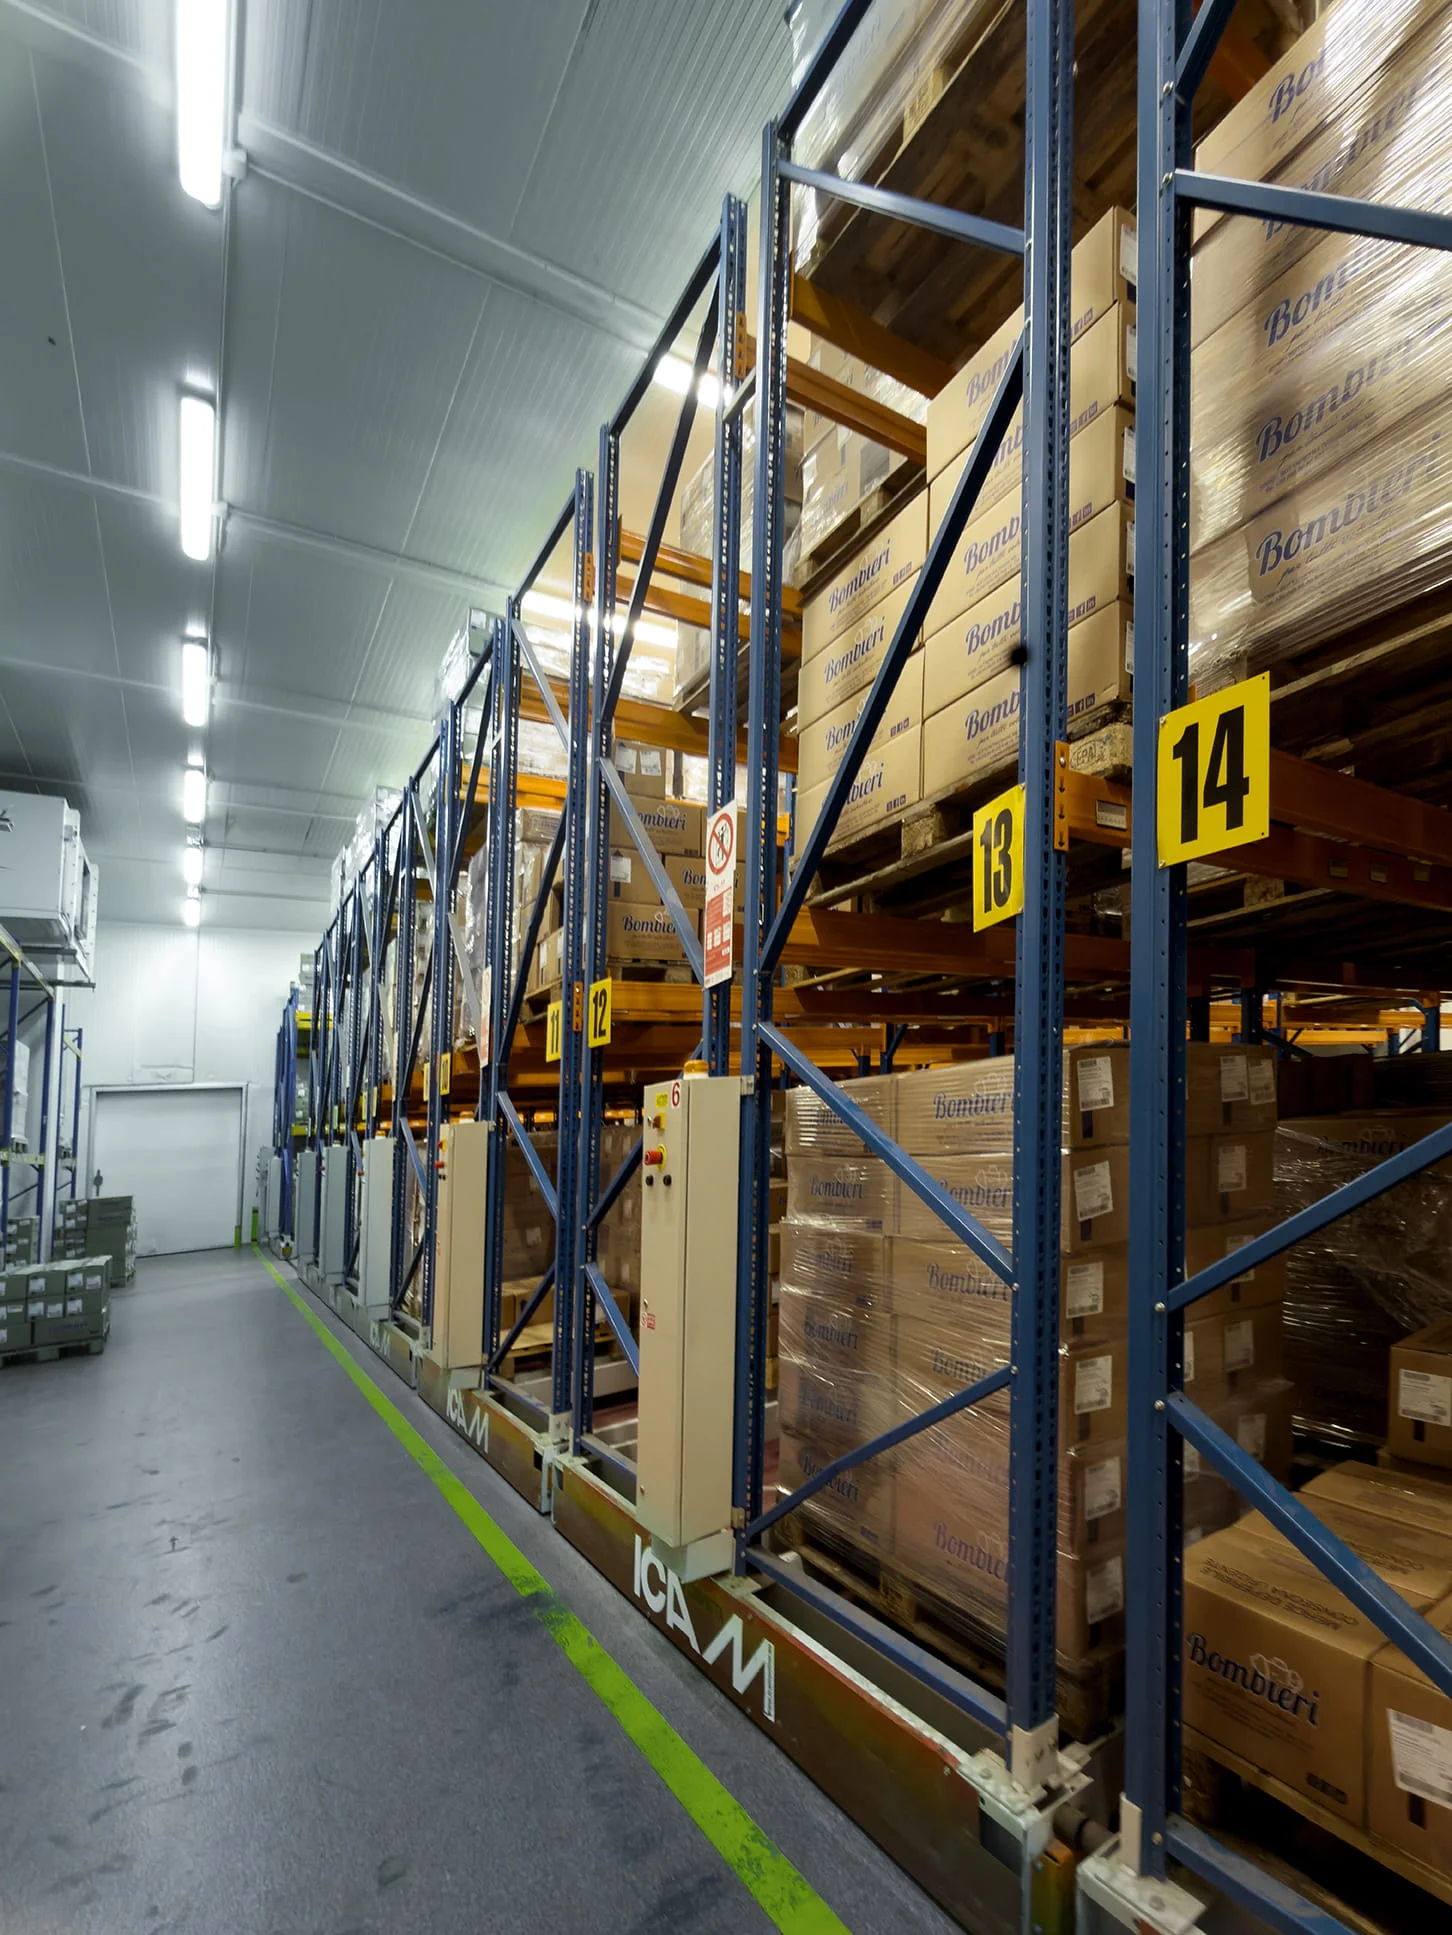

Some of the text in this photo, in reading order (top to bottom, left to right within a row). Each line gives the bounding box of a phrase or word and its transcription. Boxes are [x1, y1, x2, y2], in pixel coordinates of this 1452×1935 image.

[964, 516, 1020, 575] Bomb
[829, 537, 890, 614] Bombieri
[824, 616, 885, 684] Bombieri
[966, 602, 1020, 655] Bomb
[965, 691, 1019, 741] Bomb
[846, 763, 884, 805] bieri
[1172, 705, 1249, 845] 14
[638, 812, 686, 830] ombieri
[980, 809, 1012, 914] 13
[623, 915, 676, 934] Bombie
[551, 1010, 559, 1054] 11
[593, 989, 607, 1039] 12
[672, 1082, 680, 1107] 6
[933, 1092, 1014, 1119] Bombier
[935, 1522, 1009, 1583] Bombie
[635, 1534, 775, 1723] ICAM
[1188, 1631, 1320, 1727] Bombieri
